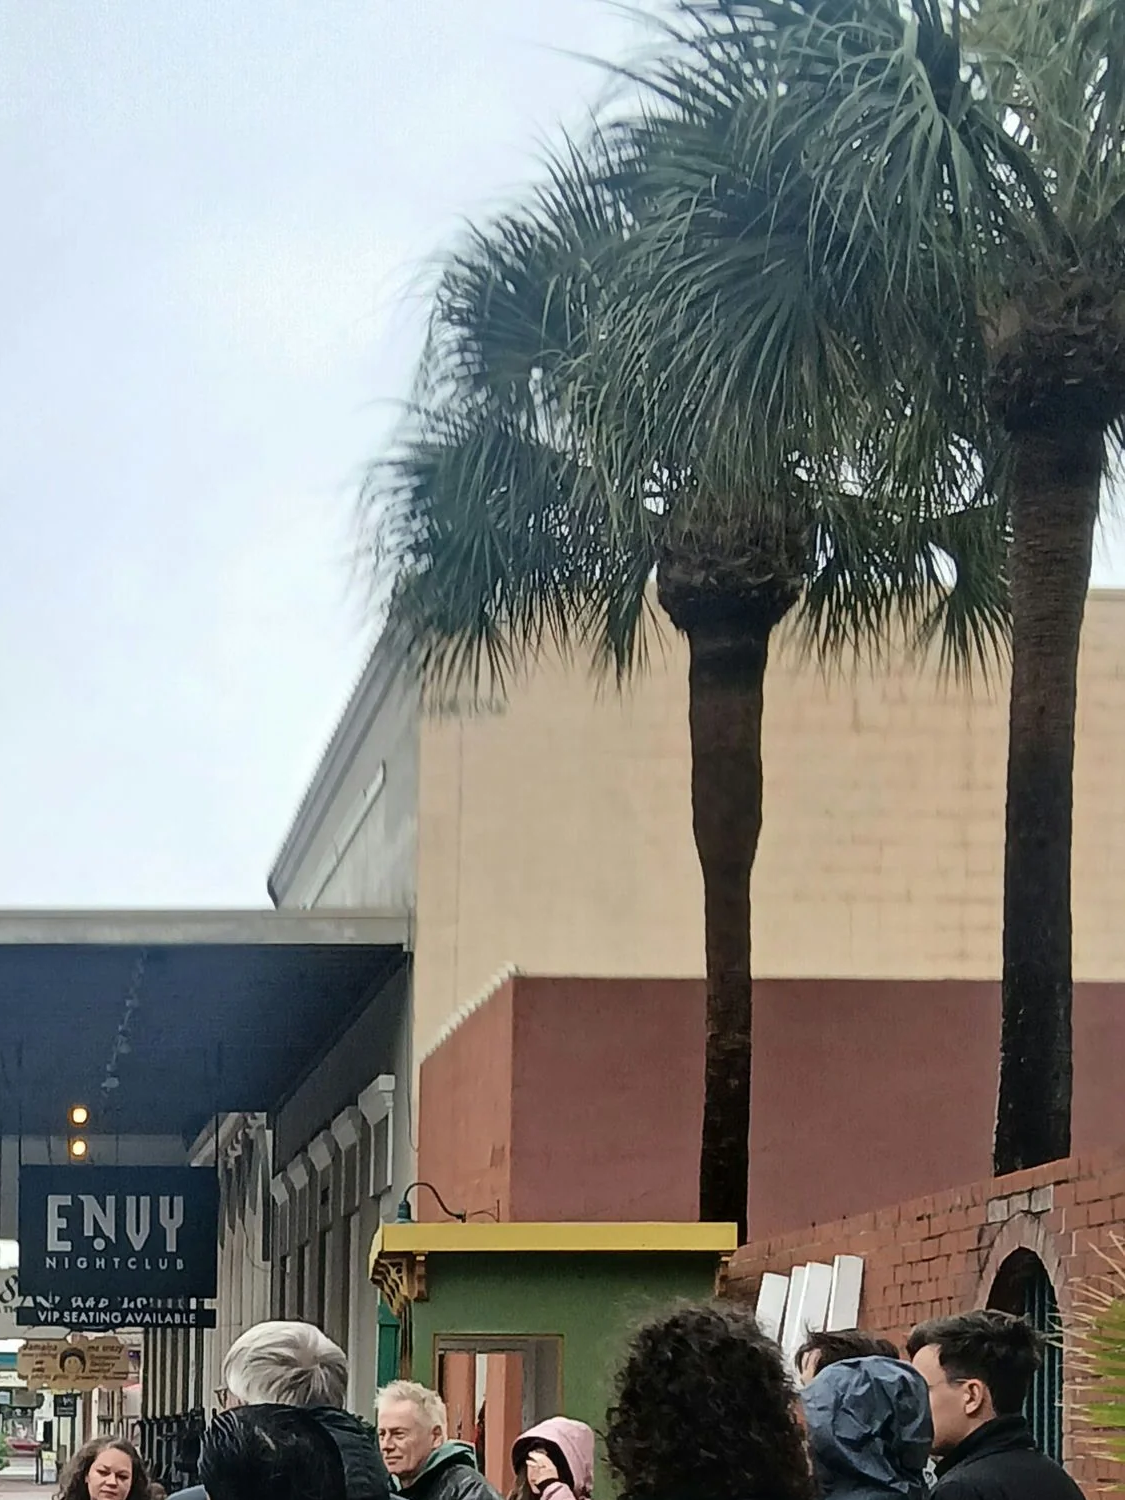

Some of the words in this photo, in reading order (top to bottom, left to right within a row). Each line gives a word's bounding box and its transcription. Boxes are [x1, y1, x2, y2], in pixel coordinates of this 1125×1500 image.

[46, 1194, 185, 1253] ENVY
[45, 1257, 186, 1271] NIGHTCLUB
[37, 1310, 60, 1323] VIP
[63, 1310, 122, 1324] SEATING
[125, 1311, 196, 1325] AVAILABLE
